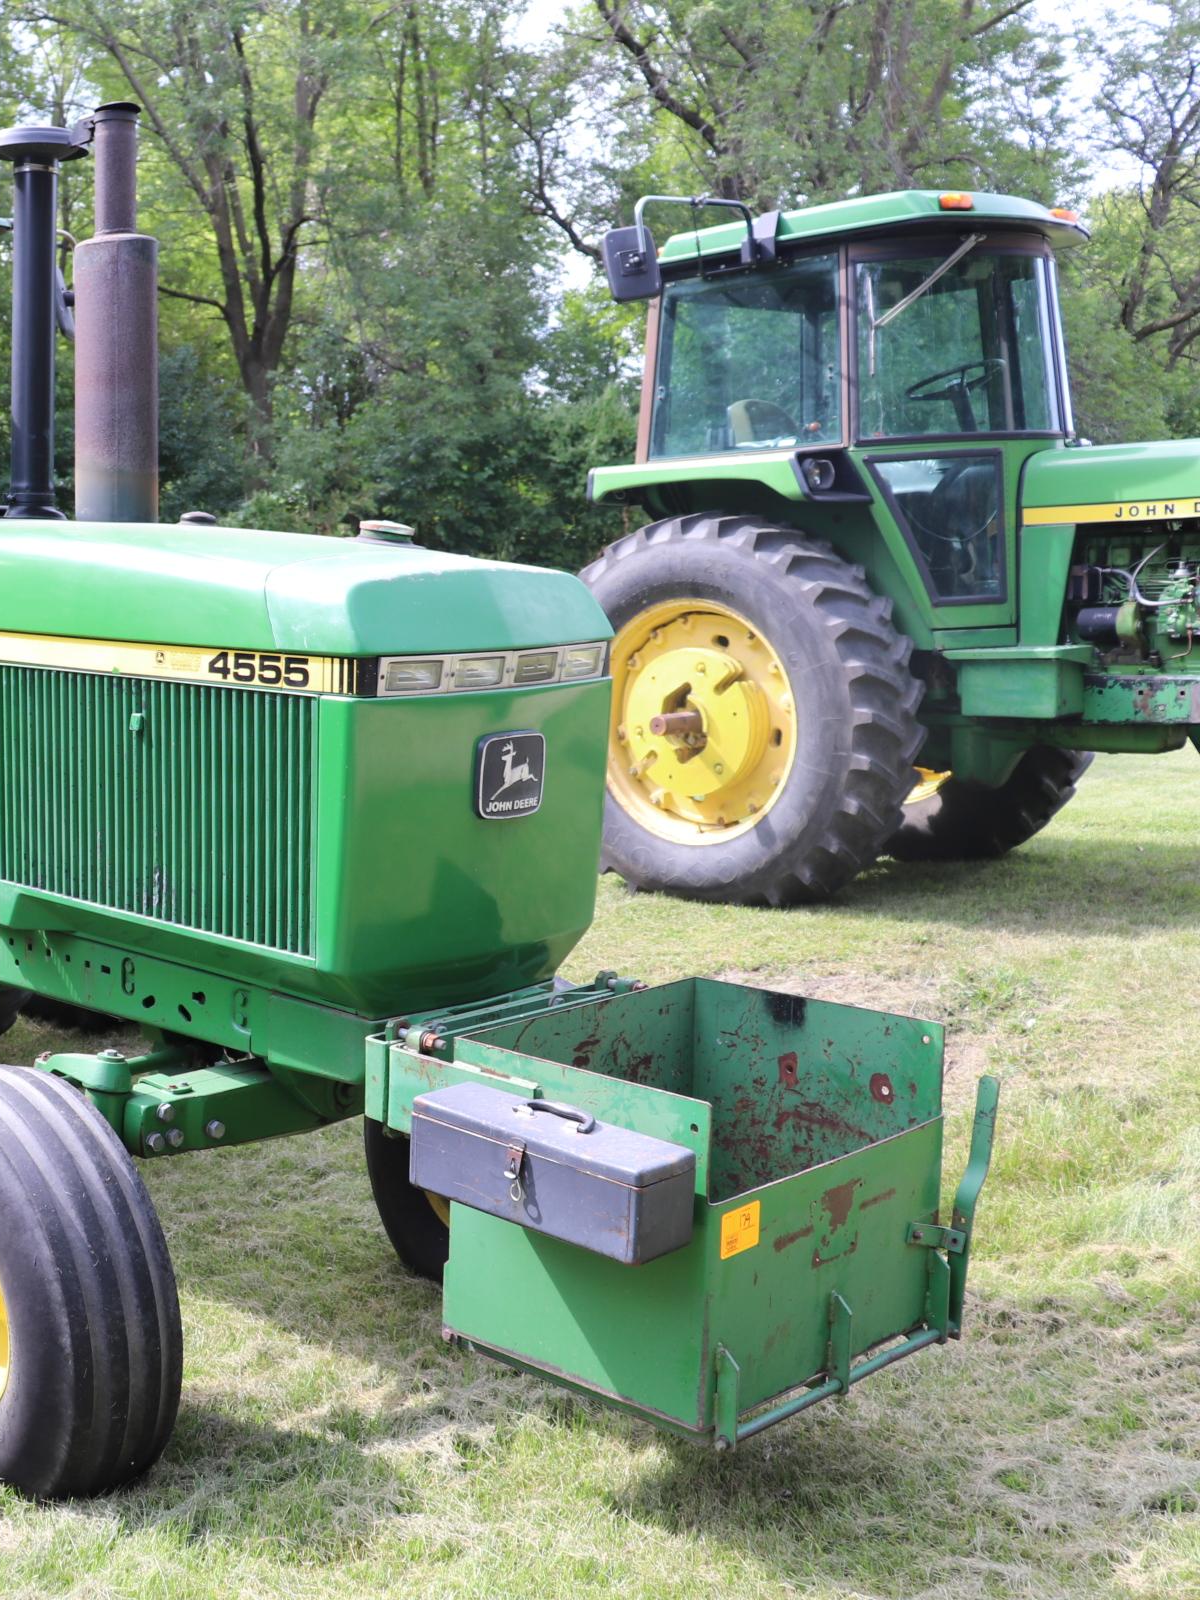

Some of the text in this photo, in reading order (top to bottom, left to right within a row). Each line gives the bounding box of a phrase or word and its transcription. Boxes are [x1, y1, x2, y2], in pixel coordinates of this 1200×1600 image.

[1115, 503, 1175, 518] JOHN
[208, 651, 310, 688] 4555
[486, 796, 538, 813] JOHN DEERE
